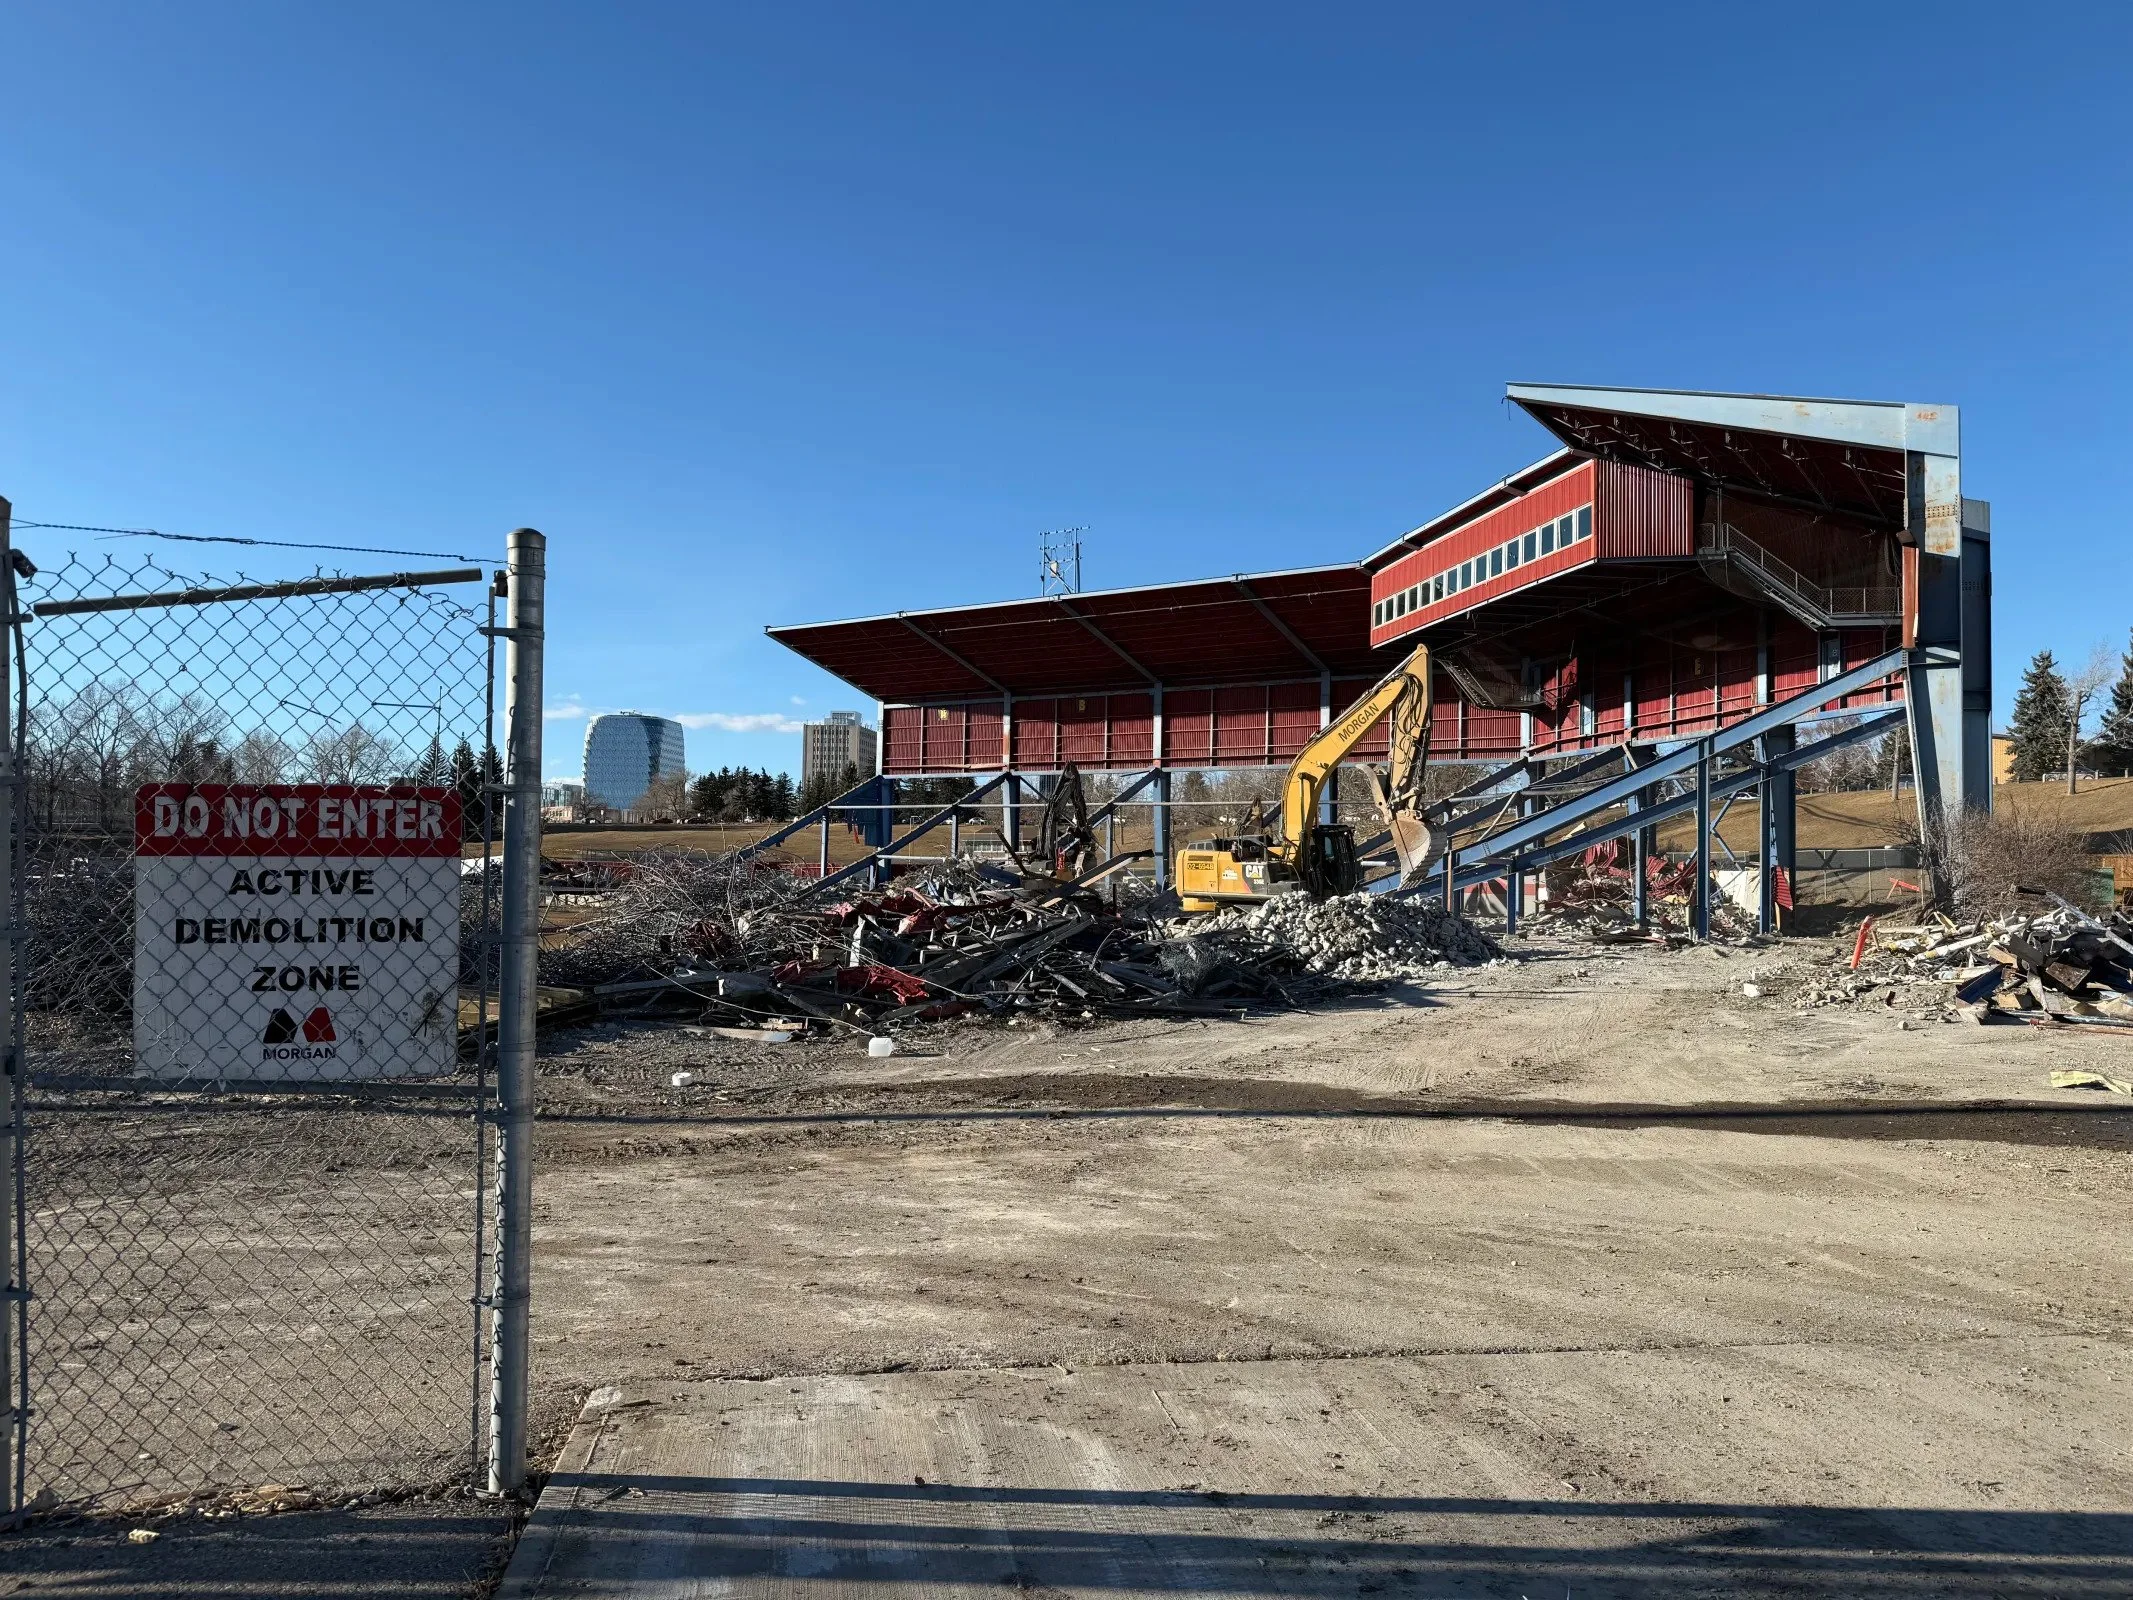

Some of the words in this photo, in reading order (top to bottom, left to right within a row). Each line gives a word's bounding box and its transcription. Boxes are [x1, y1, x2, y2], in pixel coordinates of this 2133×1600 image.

[1338, 702, 1380, 742] MORGAN
[154, 796, 210, 838] DO
[223, 797, 305, 838] NOT
[318, 798, 444, 839] ENTER
[228, 869, 375, 895] ACTIVE
[1245, 865, 1264, 879] CAT
[175, 917, 424, 944] DEMOLITION
[251, 965, 360, 991] ZONE
[262, 1047, 336, 1060] MORGAN
